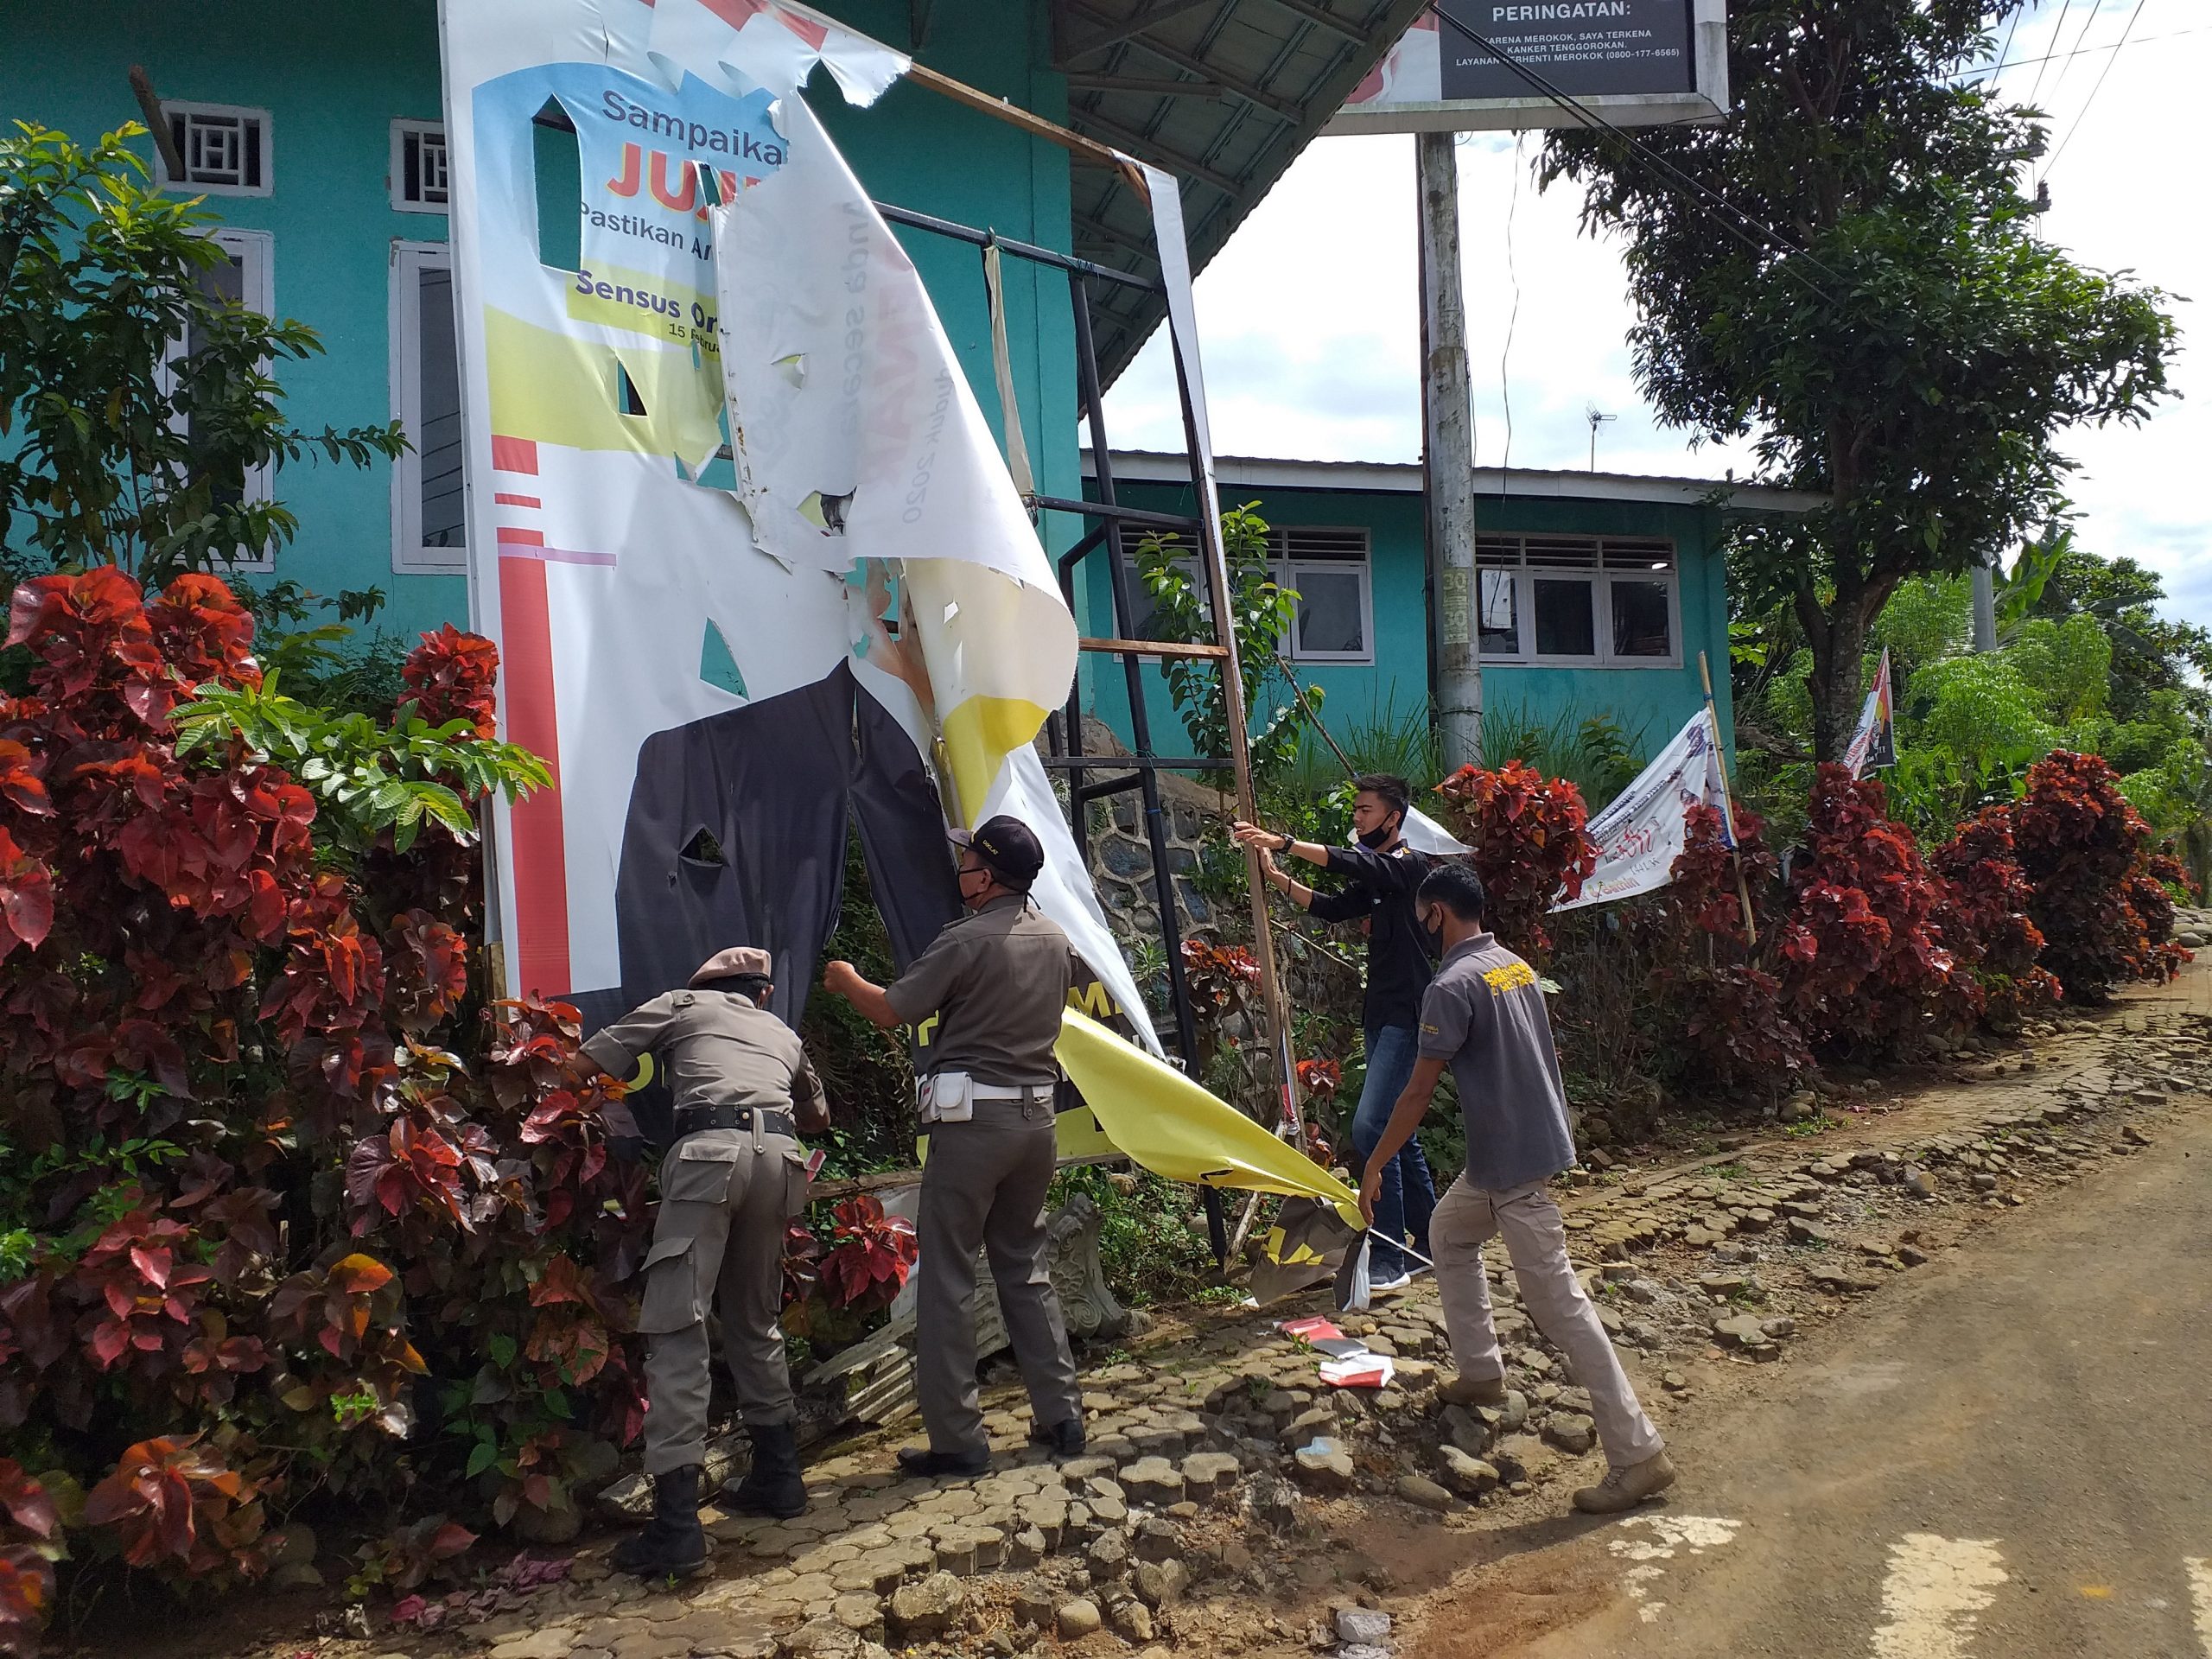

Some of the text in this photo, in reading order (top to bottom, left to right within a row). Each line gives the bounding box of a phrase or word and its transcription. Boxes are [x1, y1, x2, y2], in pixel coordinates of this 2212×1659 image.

[1492, 1, 1630, 22] PERINGATAN:
[1484, 29, 1652, 45] ARENA MEROKOK, SAYA TERKENA
[1507, 41, 1628, 54] KANKER TENGGOROKAN.
[1456, 57, 1500, 67] LAYANAN
[1554, 52, 1604, 61] MEROKOK
[1606, 48, 1680, 60] (0800-177-6565)
[575, 269, 681, 318] Sensus
[669, 322, 685, 338] 15
